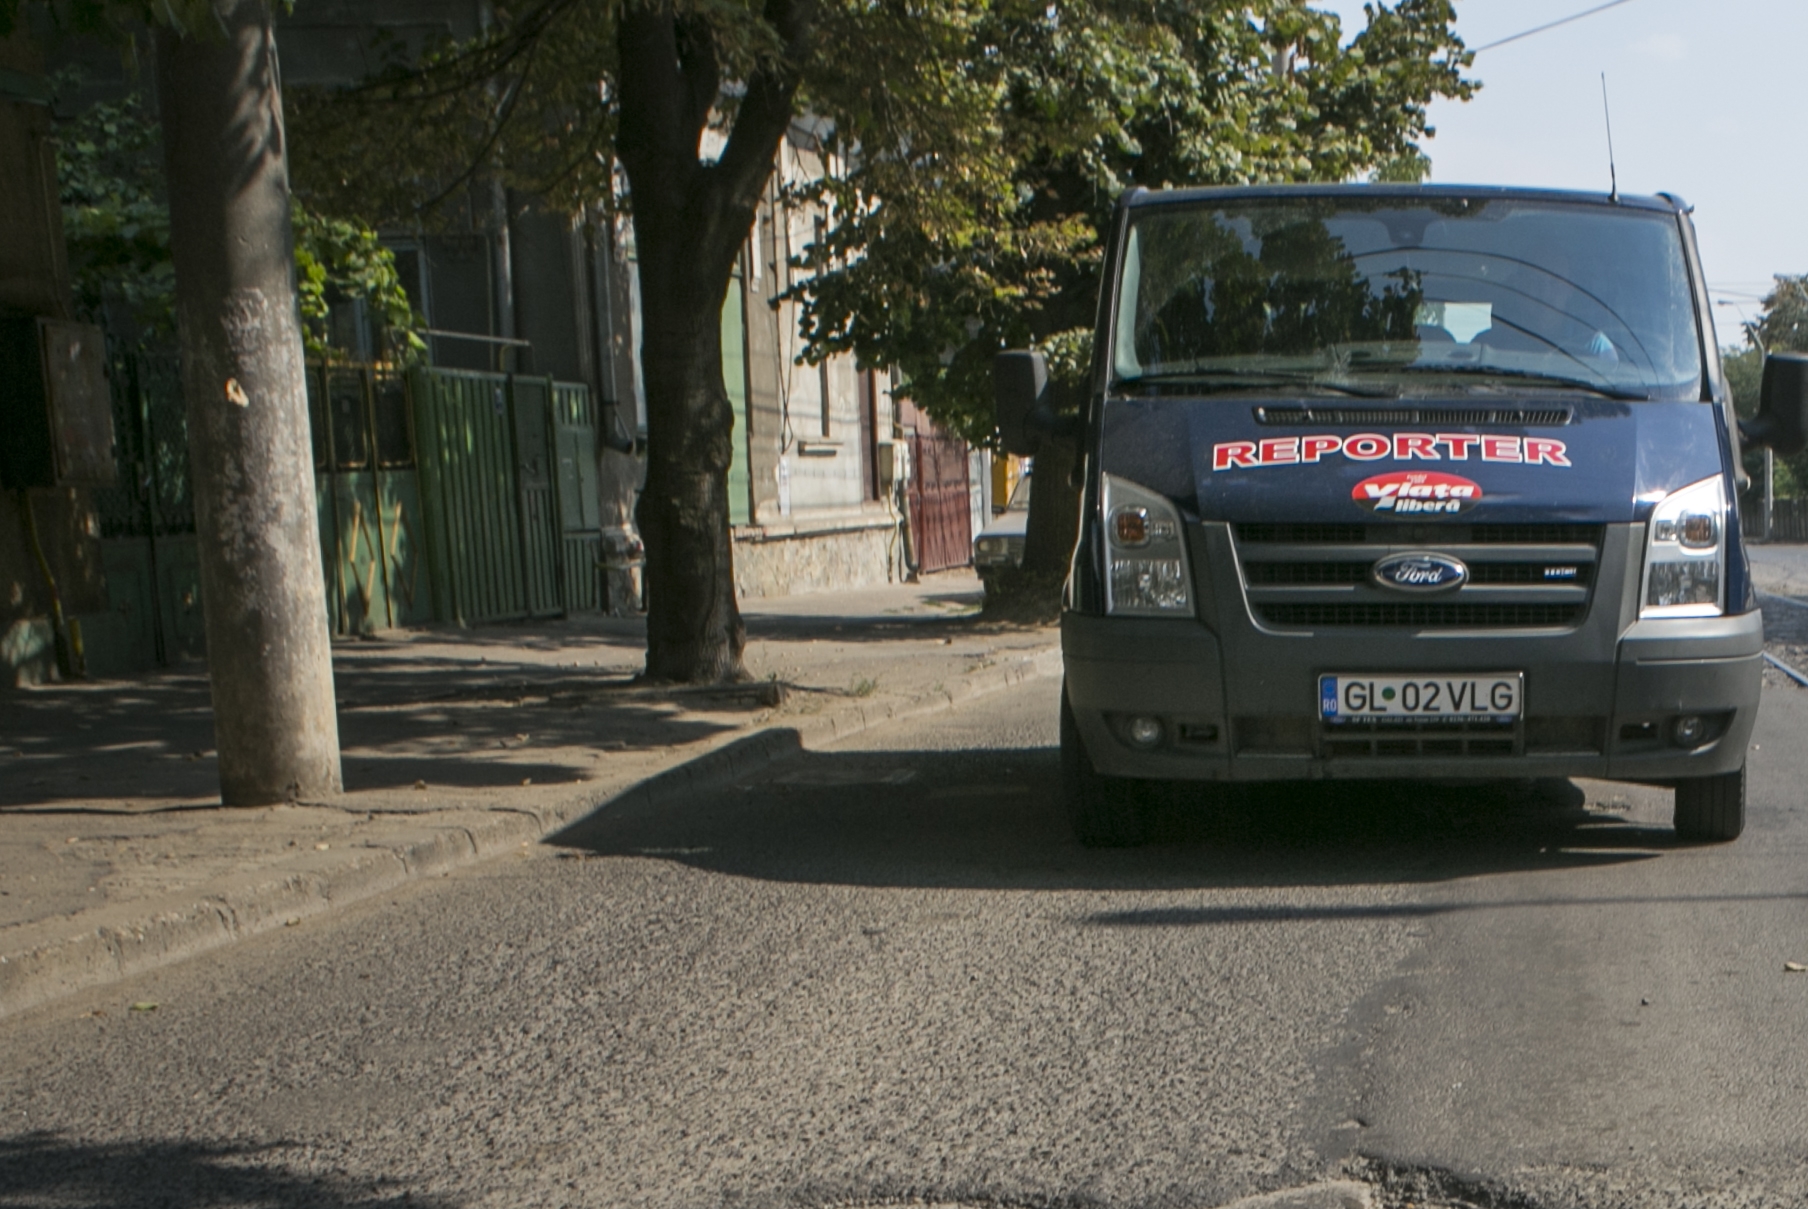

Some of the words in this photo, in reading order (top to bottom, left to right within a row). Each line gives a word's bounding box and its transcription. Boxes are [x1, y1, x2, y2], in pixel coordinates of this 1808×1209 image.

[1213, 433, 1572, 470] REPORTER
[1395, 561, 1443, 583] Ford
[1323, 698, 1337, 712] RO
[1344, 681, 1388, 712] GL
